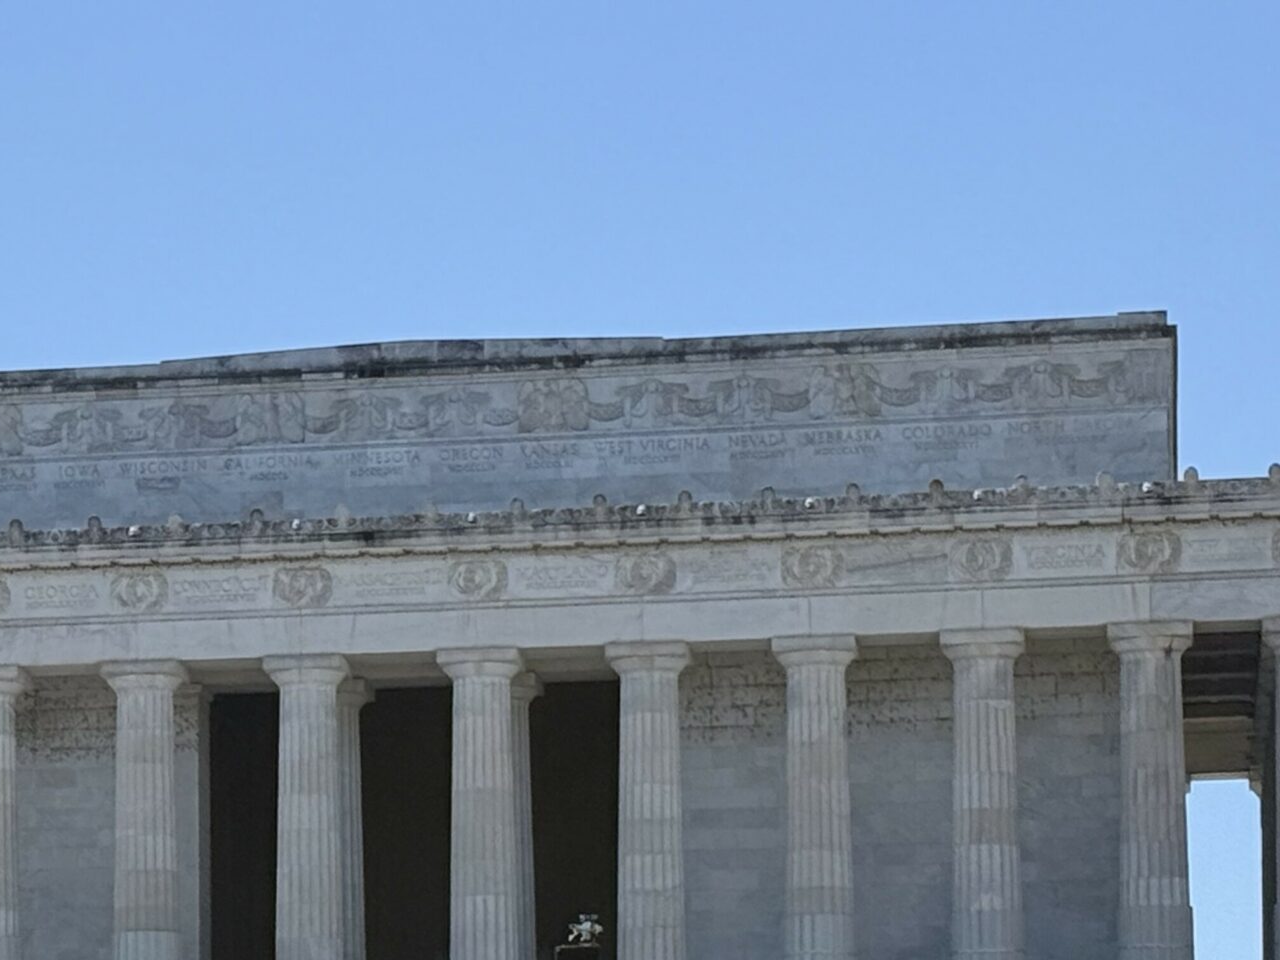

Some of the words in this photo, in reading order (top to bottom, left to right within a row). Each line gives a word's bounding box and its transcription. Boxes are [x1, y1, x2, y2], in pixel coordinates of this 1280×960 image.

[118, 459, 208, 476] WISCONSIN
[439, 446, 504, 461] OREGON
[640, 437, 710, 452] VIRGINIA
[728, 433, 786, 449] NEVADA
[804, 429, 884, 446] NEBRASKA
[902, 423, 993, 440] COLORADO
